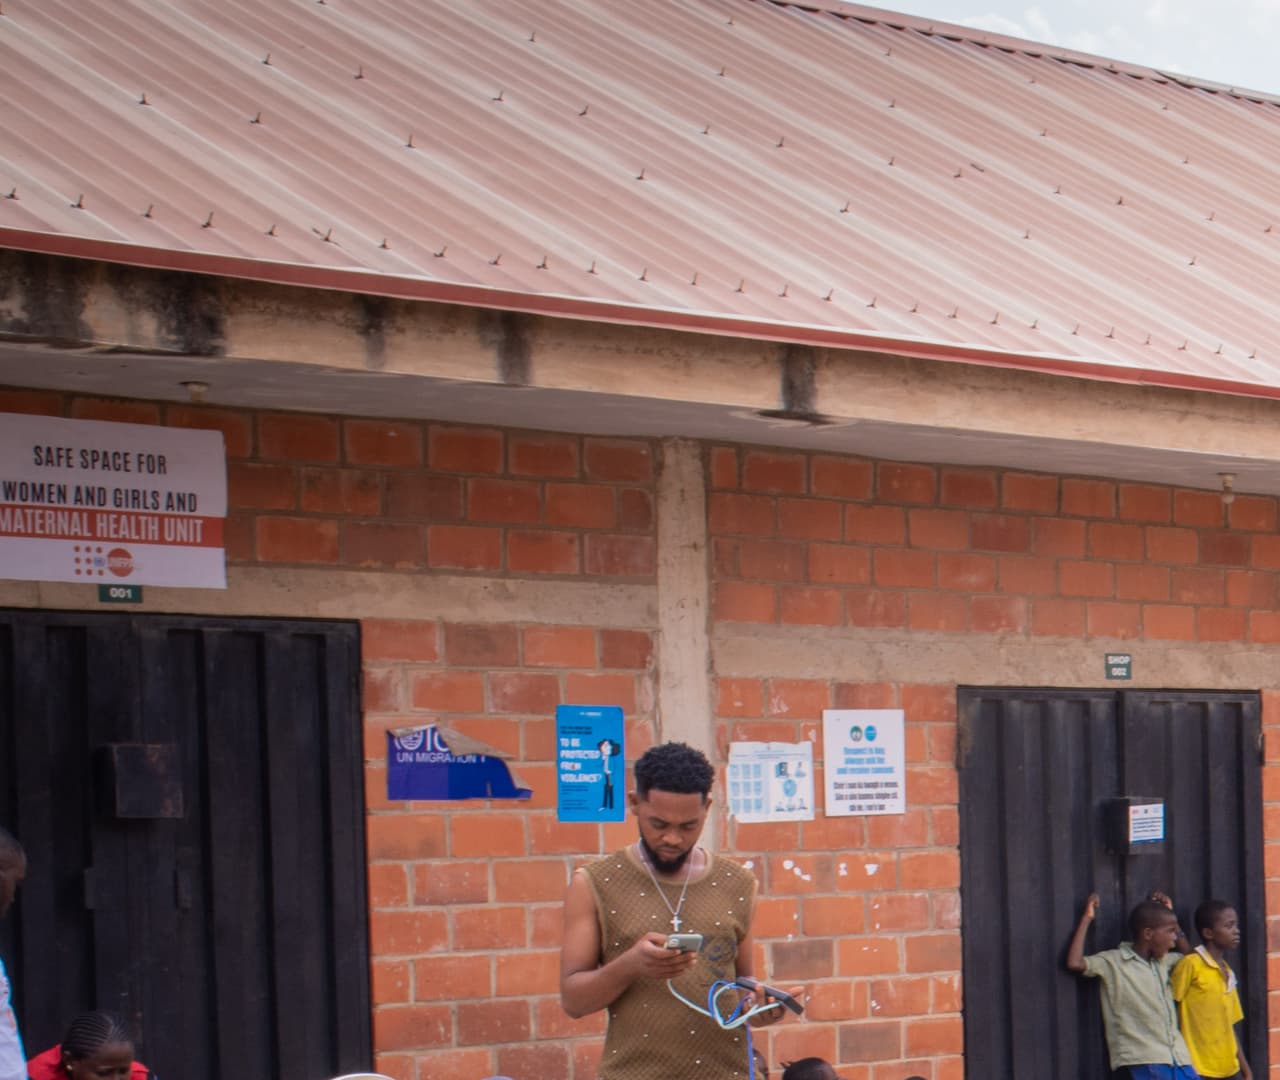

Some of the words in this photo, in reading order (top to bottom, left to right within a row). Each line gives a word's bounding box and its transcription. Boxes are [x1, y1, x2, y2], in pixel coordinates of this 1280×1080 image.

[33, 445, 73, 468] SAFE
[80, 449, 131, 473] SPACE
[137, 453, 168, 475] FOR
[2, 480, 67, 504] WOMEN
[74, 485, 106, 507] AND
[113, 488, 159, 511] GIRLS
[165, 492, 197, 513] AND
[0, 508, 92, 537] MATERNAL
[96, 514, 159, 541] HEALTH
[164, 518, 203, 543] UNIT
[109, 587, 133, 599] 001
[1108, 656, 1130, 664] SHOP
[397, 752, 414, 763] UN
